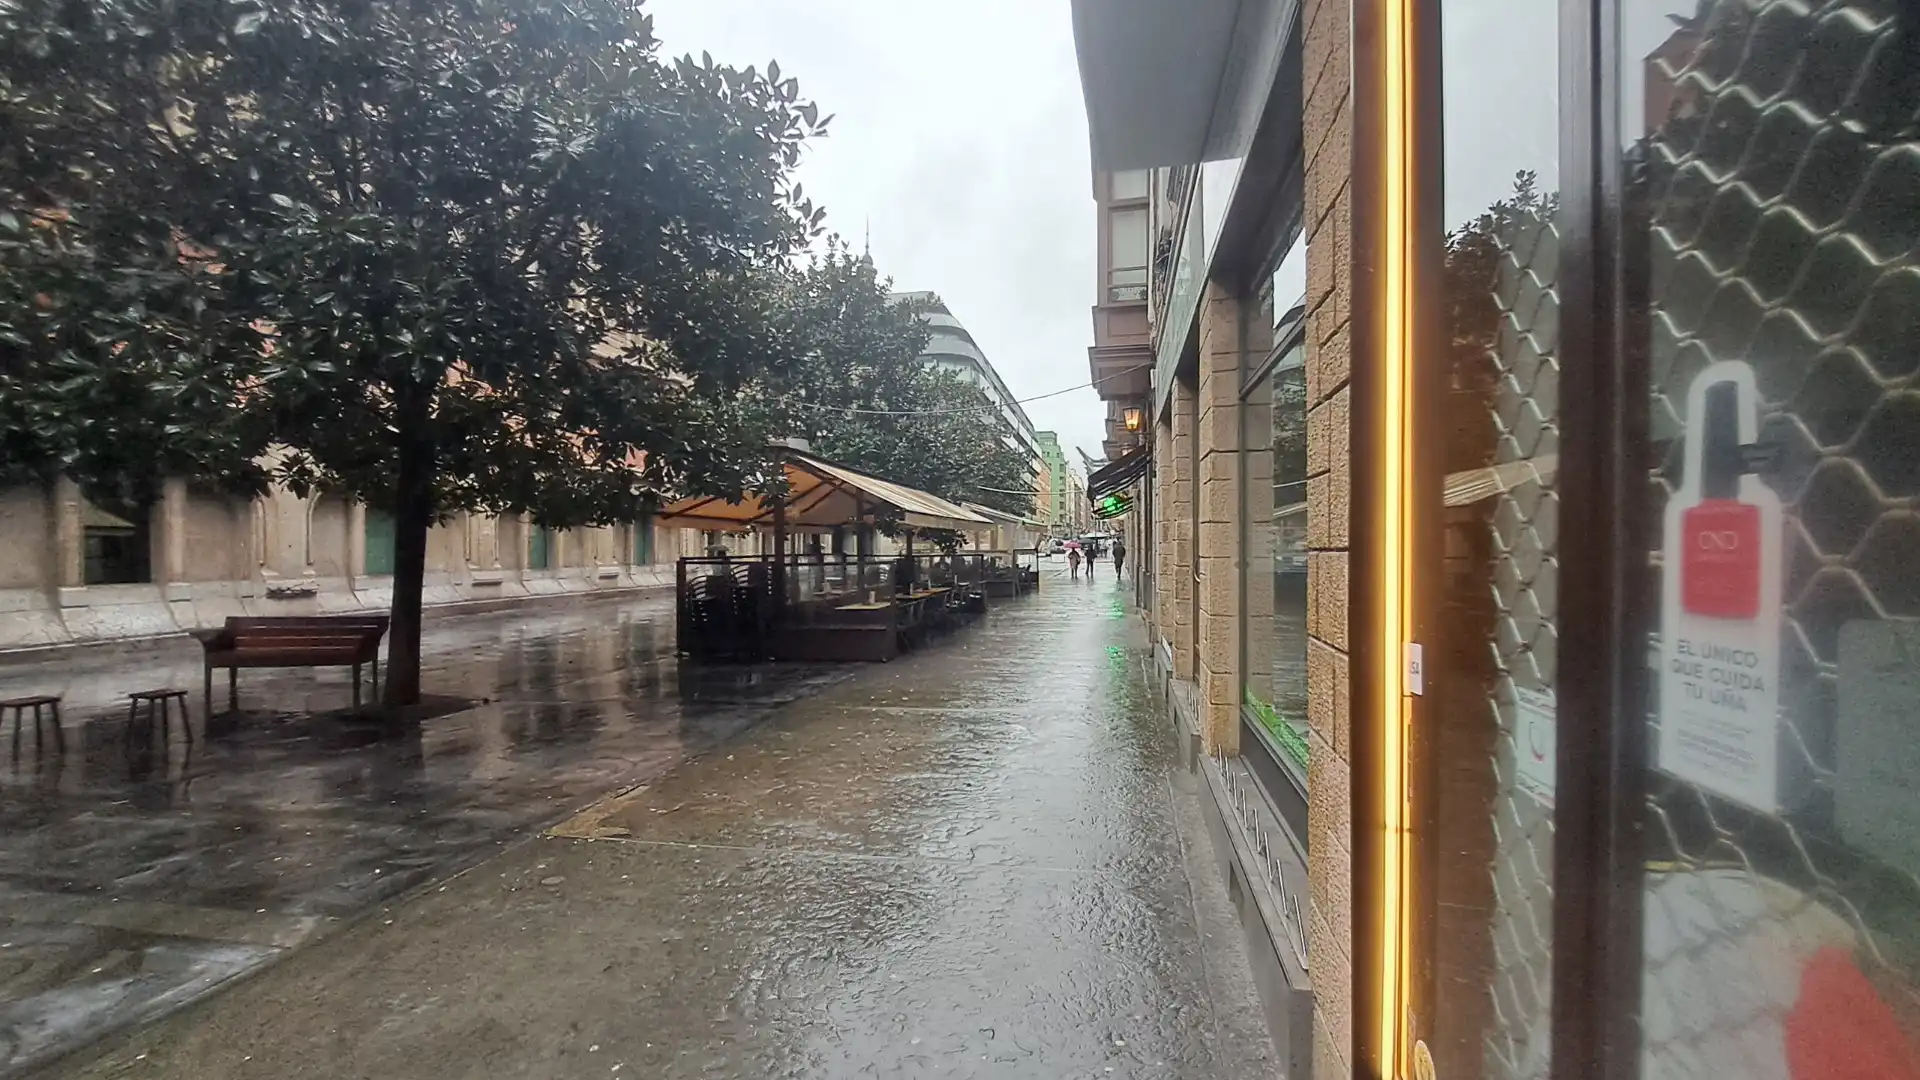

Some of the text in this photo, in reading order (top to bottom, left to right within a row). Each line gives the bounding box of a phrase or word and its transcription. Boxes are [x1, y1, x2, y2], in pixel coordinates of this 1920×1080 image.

[1677, 639, 1699, 657] EL
[1670, 658, 1765, 693] QUE CUIDA
[1681, 681, 1748, 713] TU UÑA
